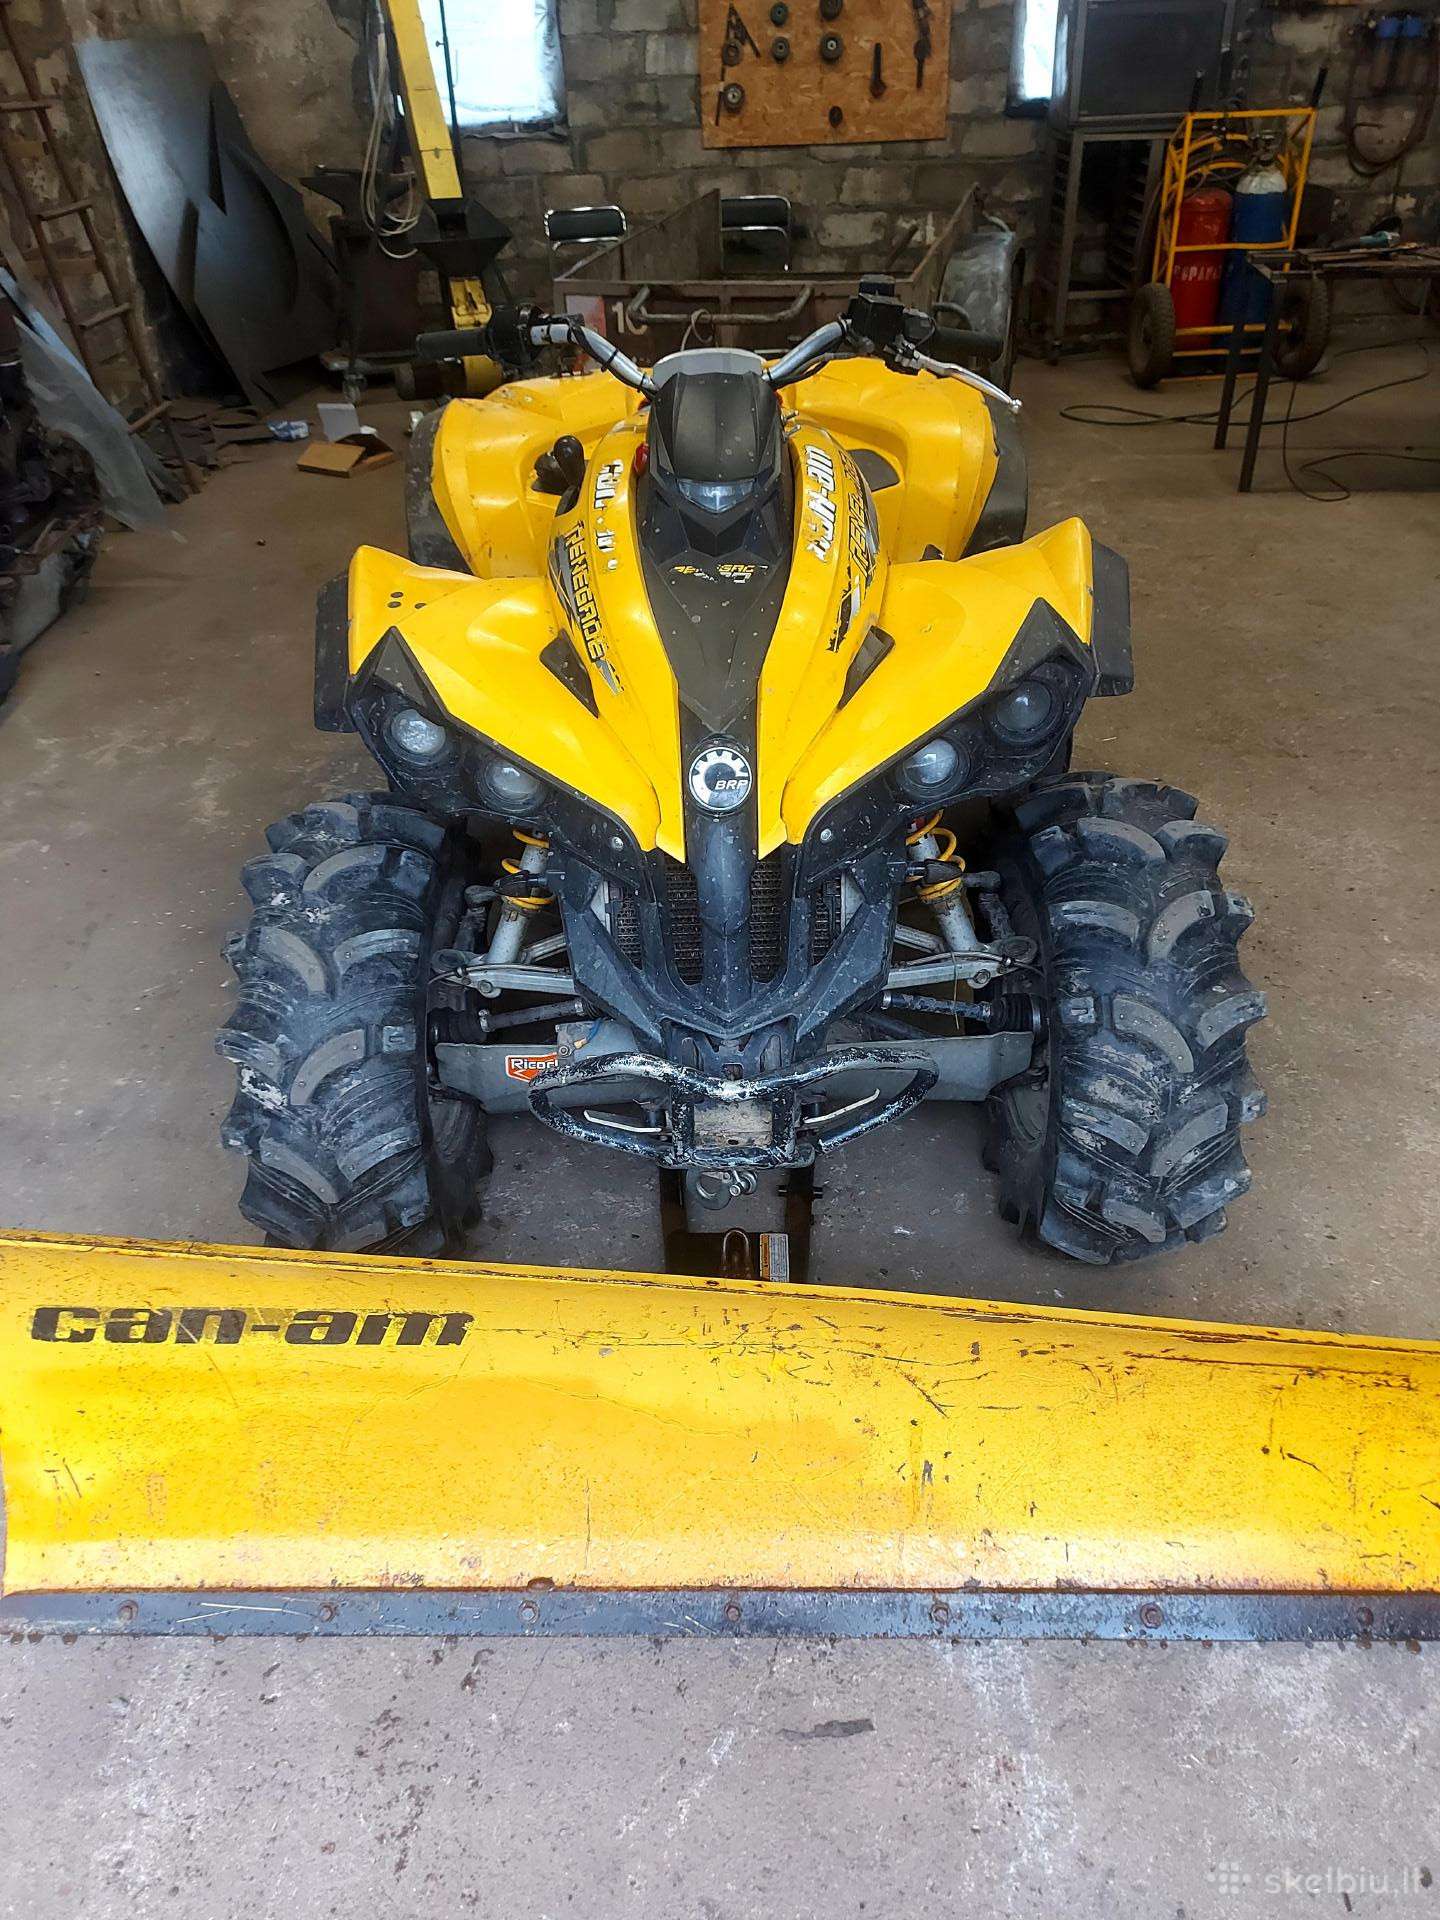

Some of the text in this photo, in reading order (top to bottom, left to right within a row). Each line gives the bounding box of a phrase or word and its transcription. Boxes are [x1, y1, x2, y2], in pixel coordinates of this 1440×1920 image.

[563, 519, 605, 663] RENEGADE
[714, 779, 748, 790] BRP
[30, 1306, 477, 1346] can-am
